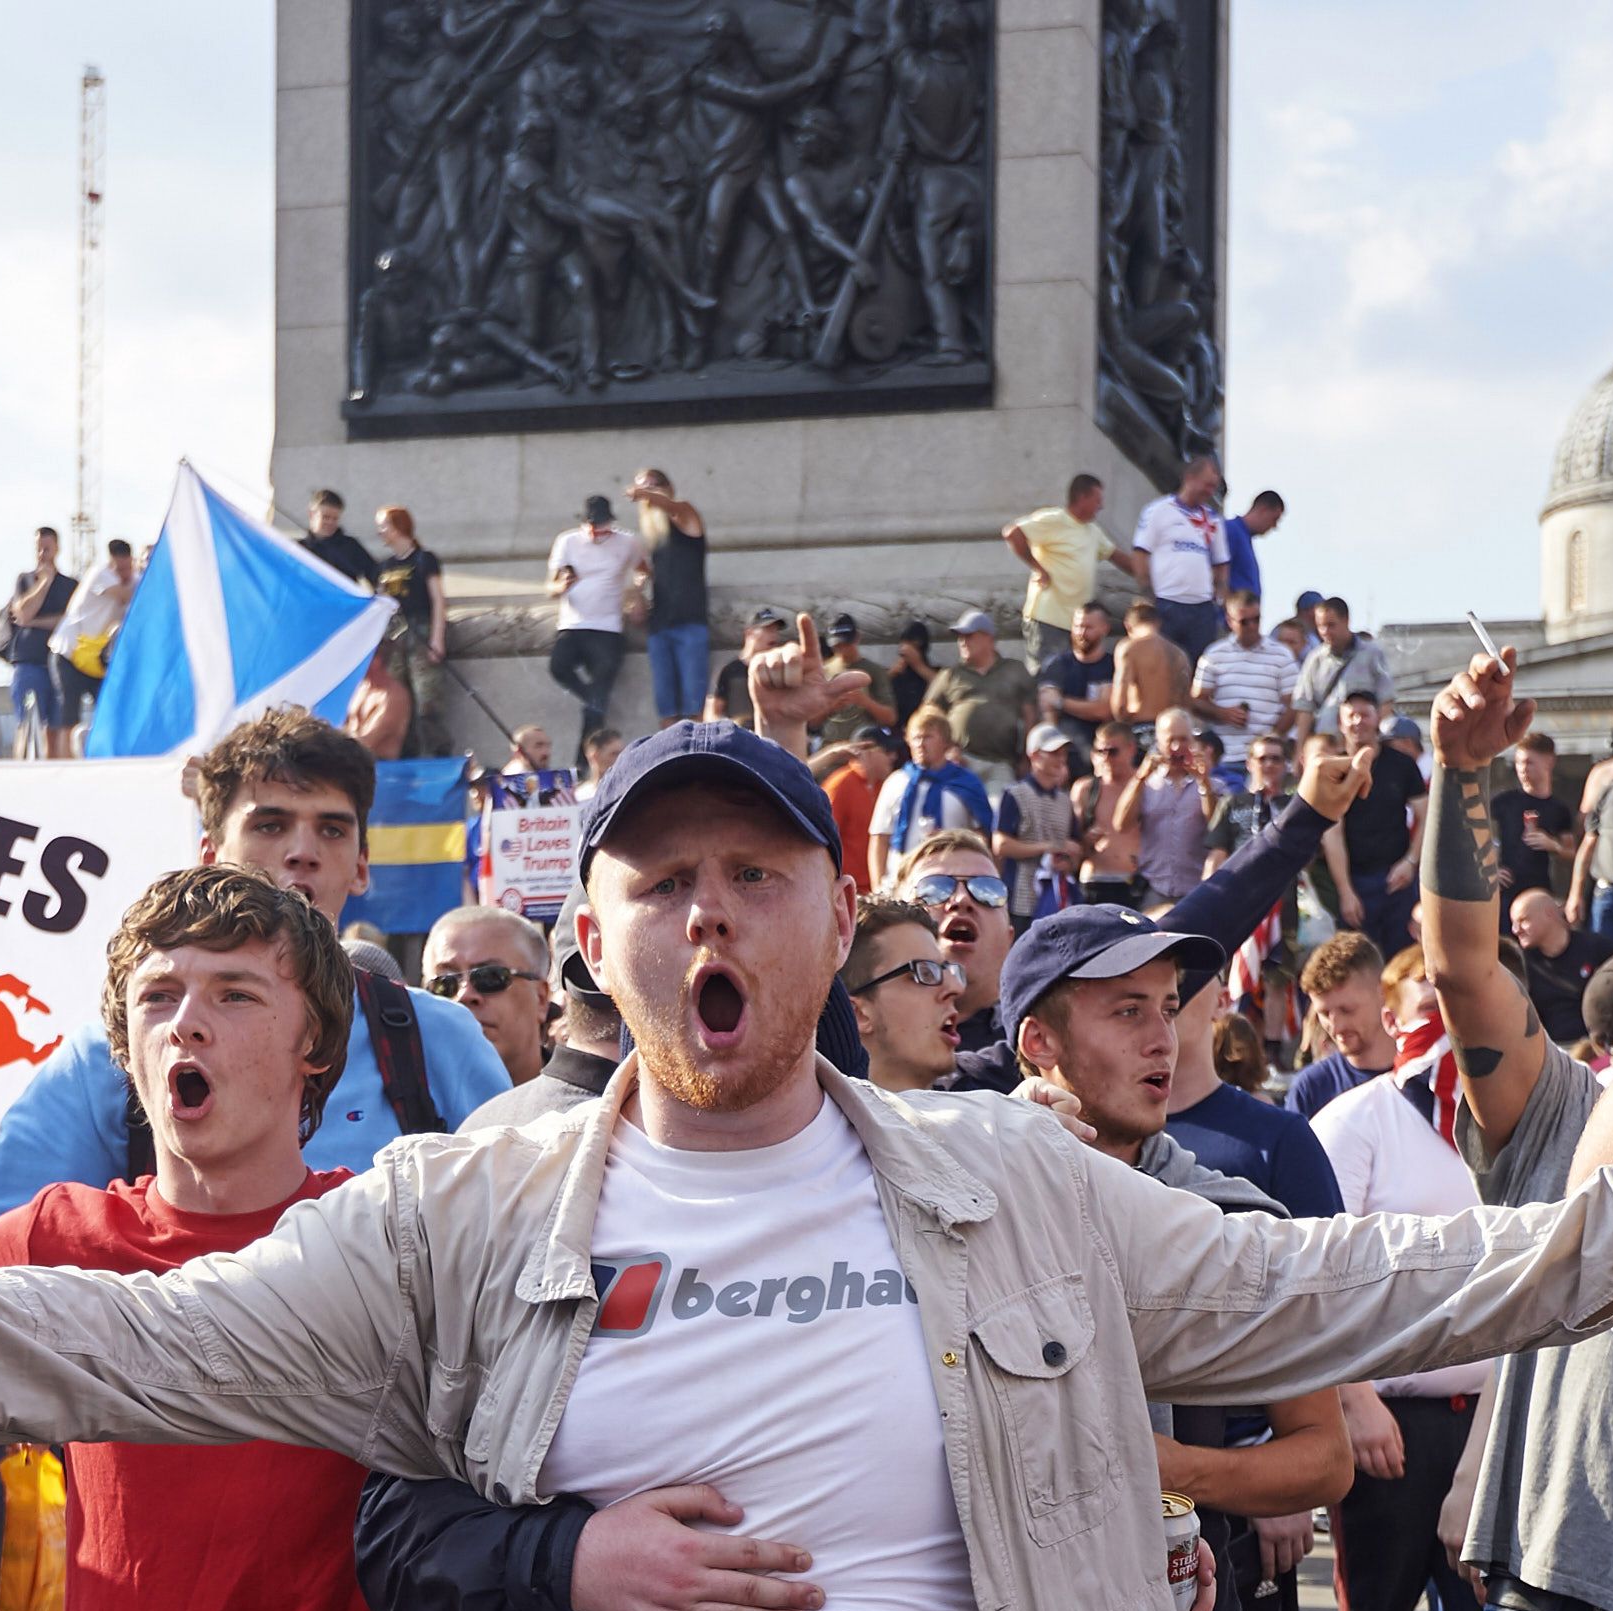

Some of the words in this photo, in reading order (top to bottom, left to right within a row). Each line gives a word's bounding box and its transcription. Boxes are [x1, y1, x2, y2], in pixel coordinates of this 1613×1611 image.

[518, 816, 570, 833] Britain
[526, 837, 571, 850] Loves
[523, 857, 572, 873] Trump
